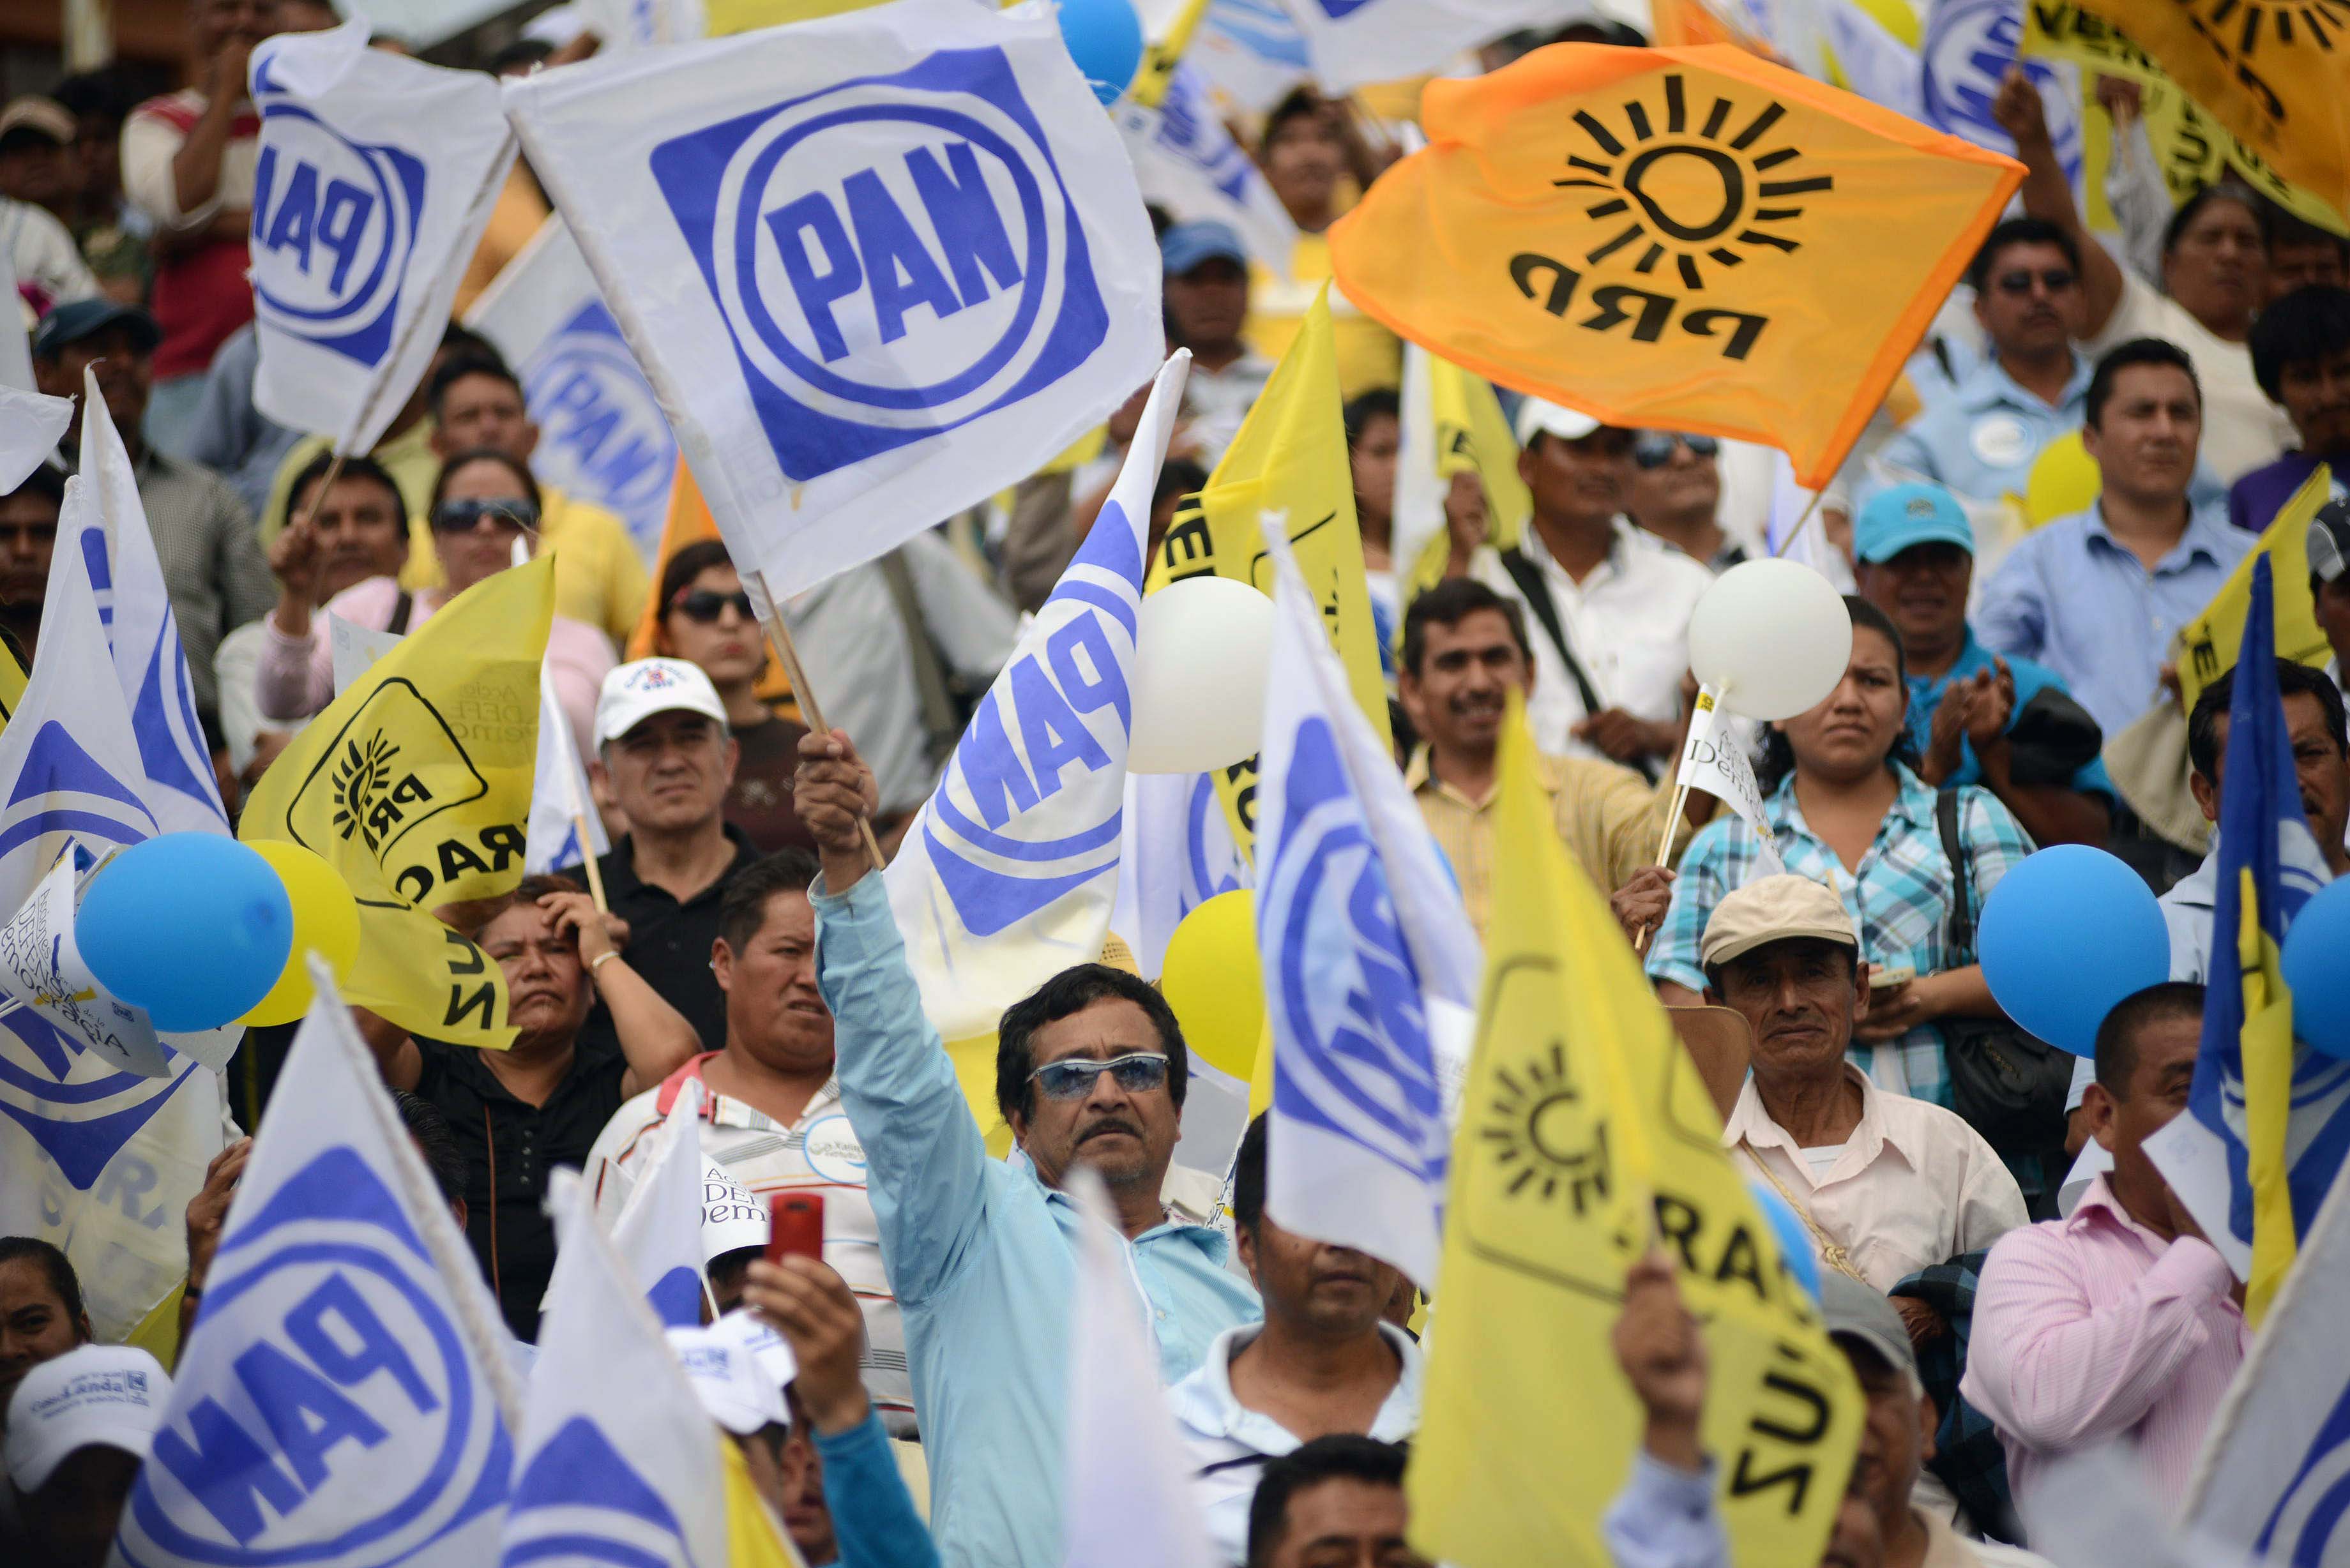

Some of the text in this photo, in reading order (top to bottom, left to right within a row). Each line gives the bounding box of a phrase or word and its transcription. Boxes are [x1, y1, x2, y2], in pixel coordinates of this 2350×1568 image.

[764, 140, 1024, 363] PAN
[547, 369, 660, 493] PAN
[18, 902, 81, 1014] DEFENSA
